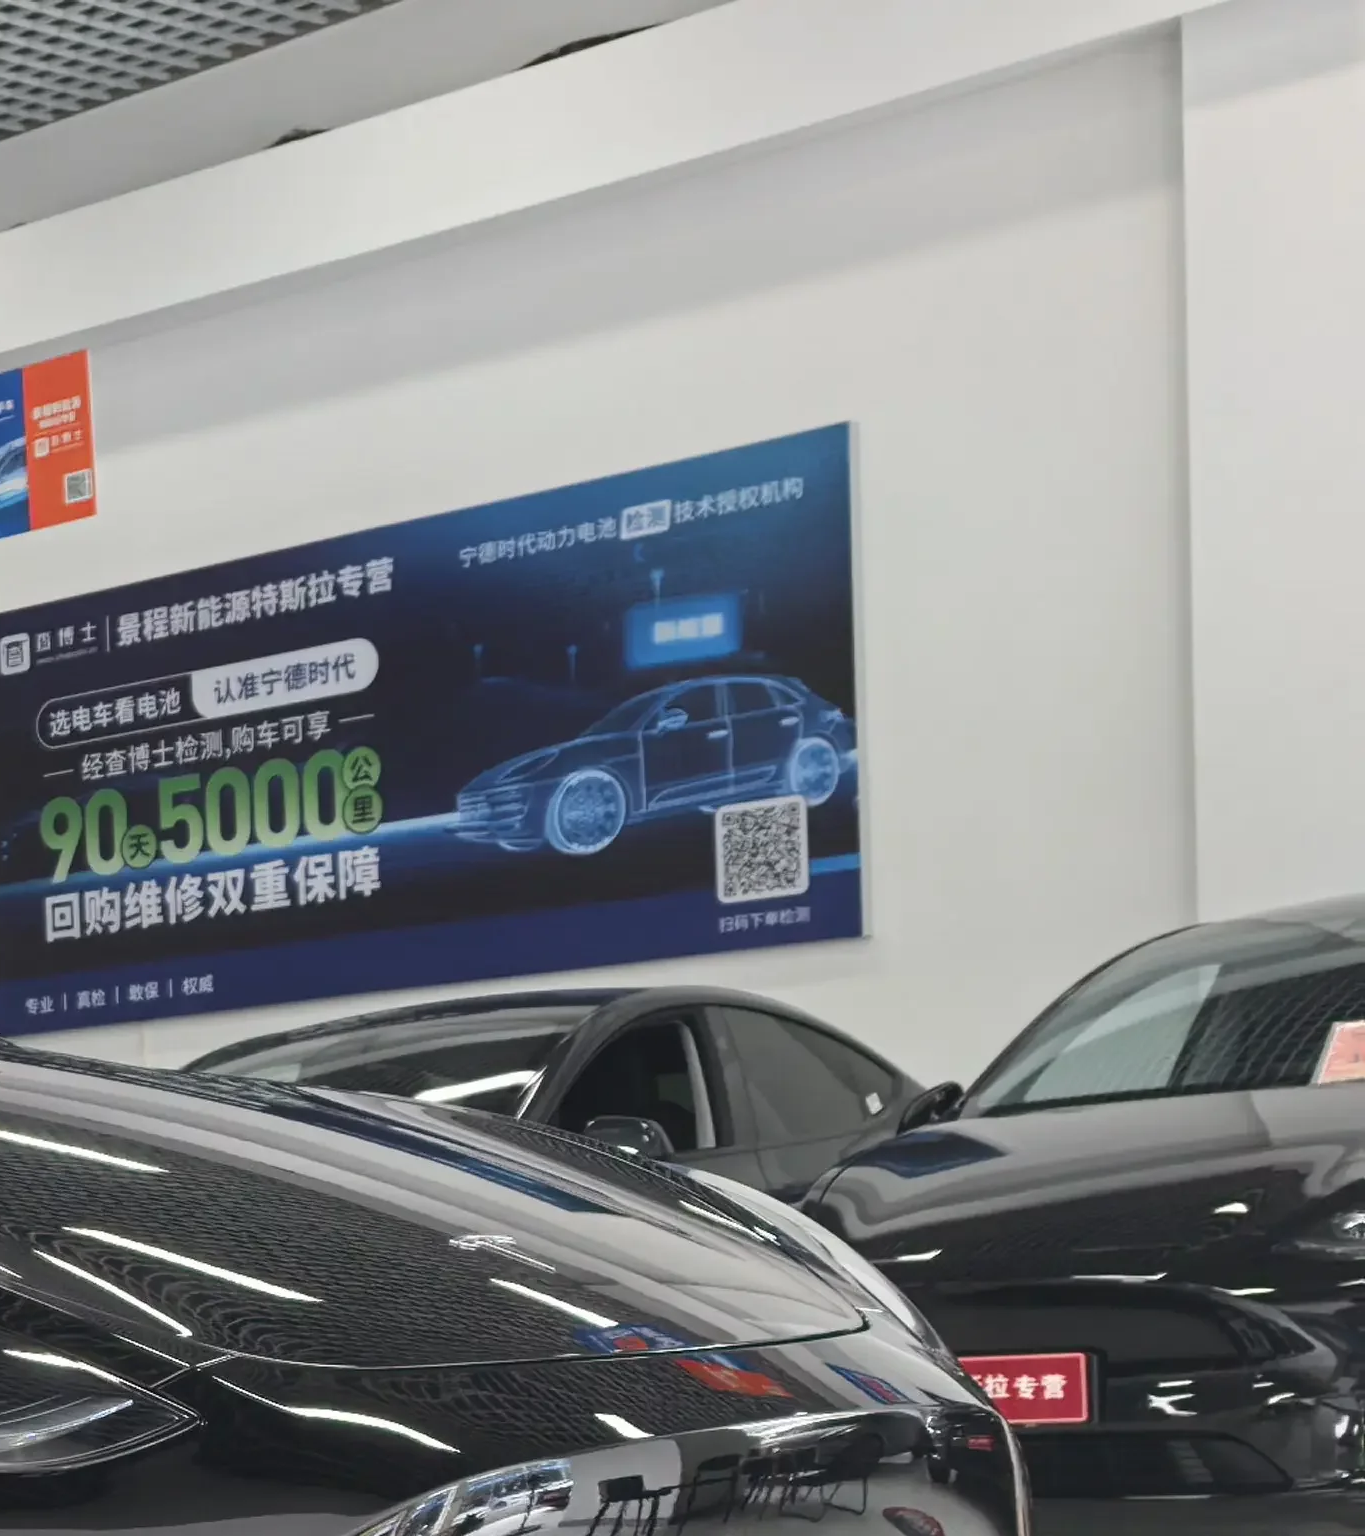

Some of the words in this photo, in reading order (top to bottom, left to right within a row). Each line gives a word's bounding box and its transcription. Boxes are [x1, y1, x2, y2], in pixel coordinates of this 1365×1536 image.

[116, 556, 395, 648] 景程新能源特斯拉专营
[48, 689, 182, 737] 选电车看电池
[213, 652, 357, 704] 认准宁德时代
[44, 846, 382, 942] 回购维修双重保障
